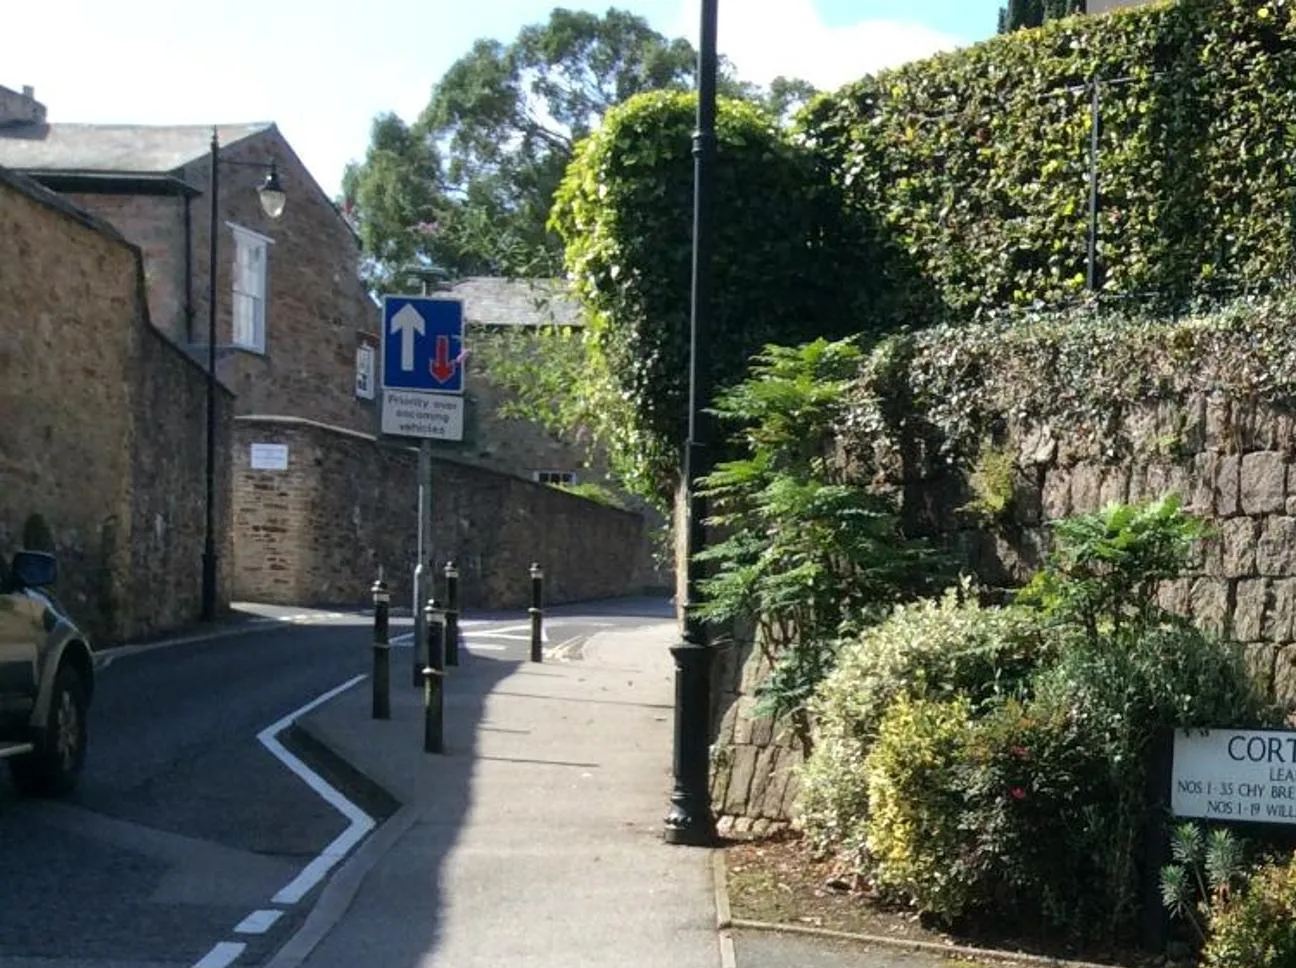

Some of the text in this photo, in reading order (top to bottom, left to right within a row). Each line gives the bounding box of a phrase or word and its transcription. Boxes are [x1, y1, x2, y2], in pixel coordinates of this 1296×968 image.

[1177, 780, 1203, 794] NOS
[1238, 783, 1266, 798] CHY
[1207, 800, 1233, 815] NOS
